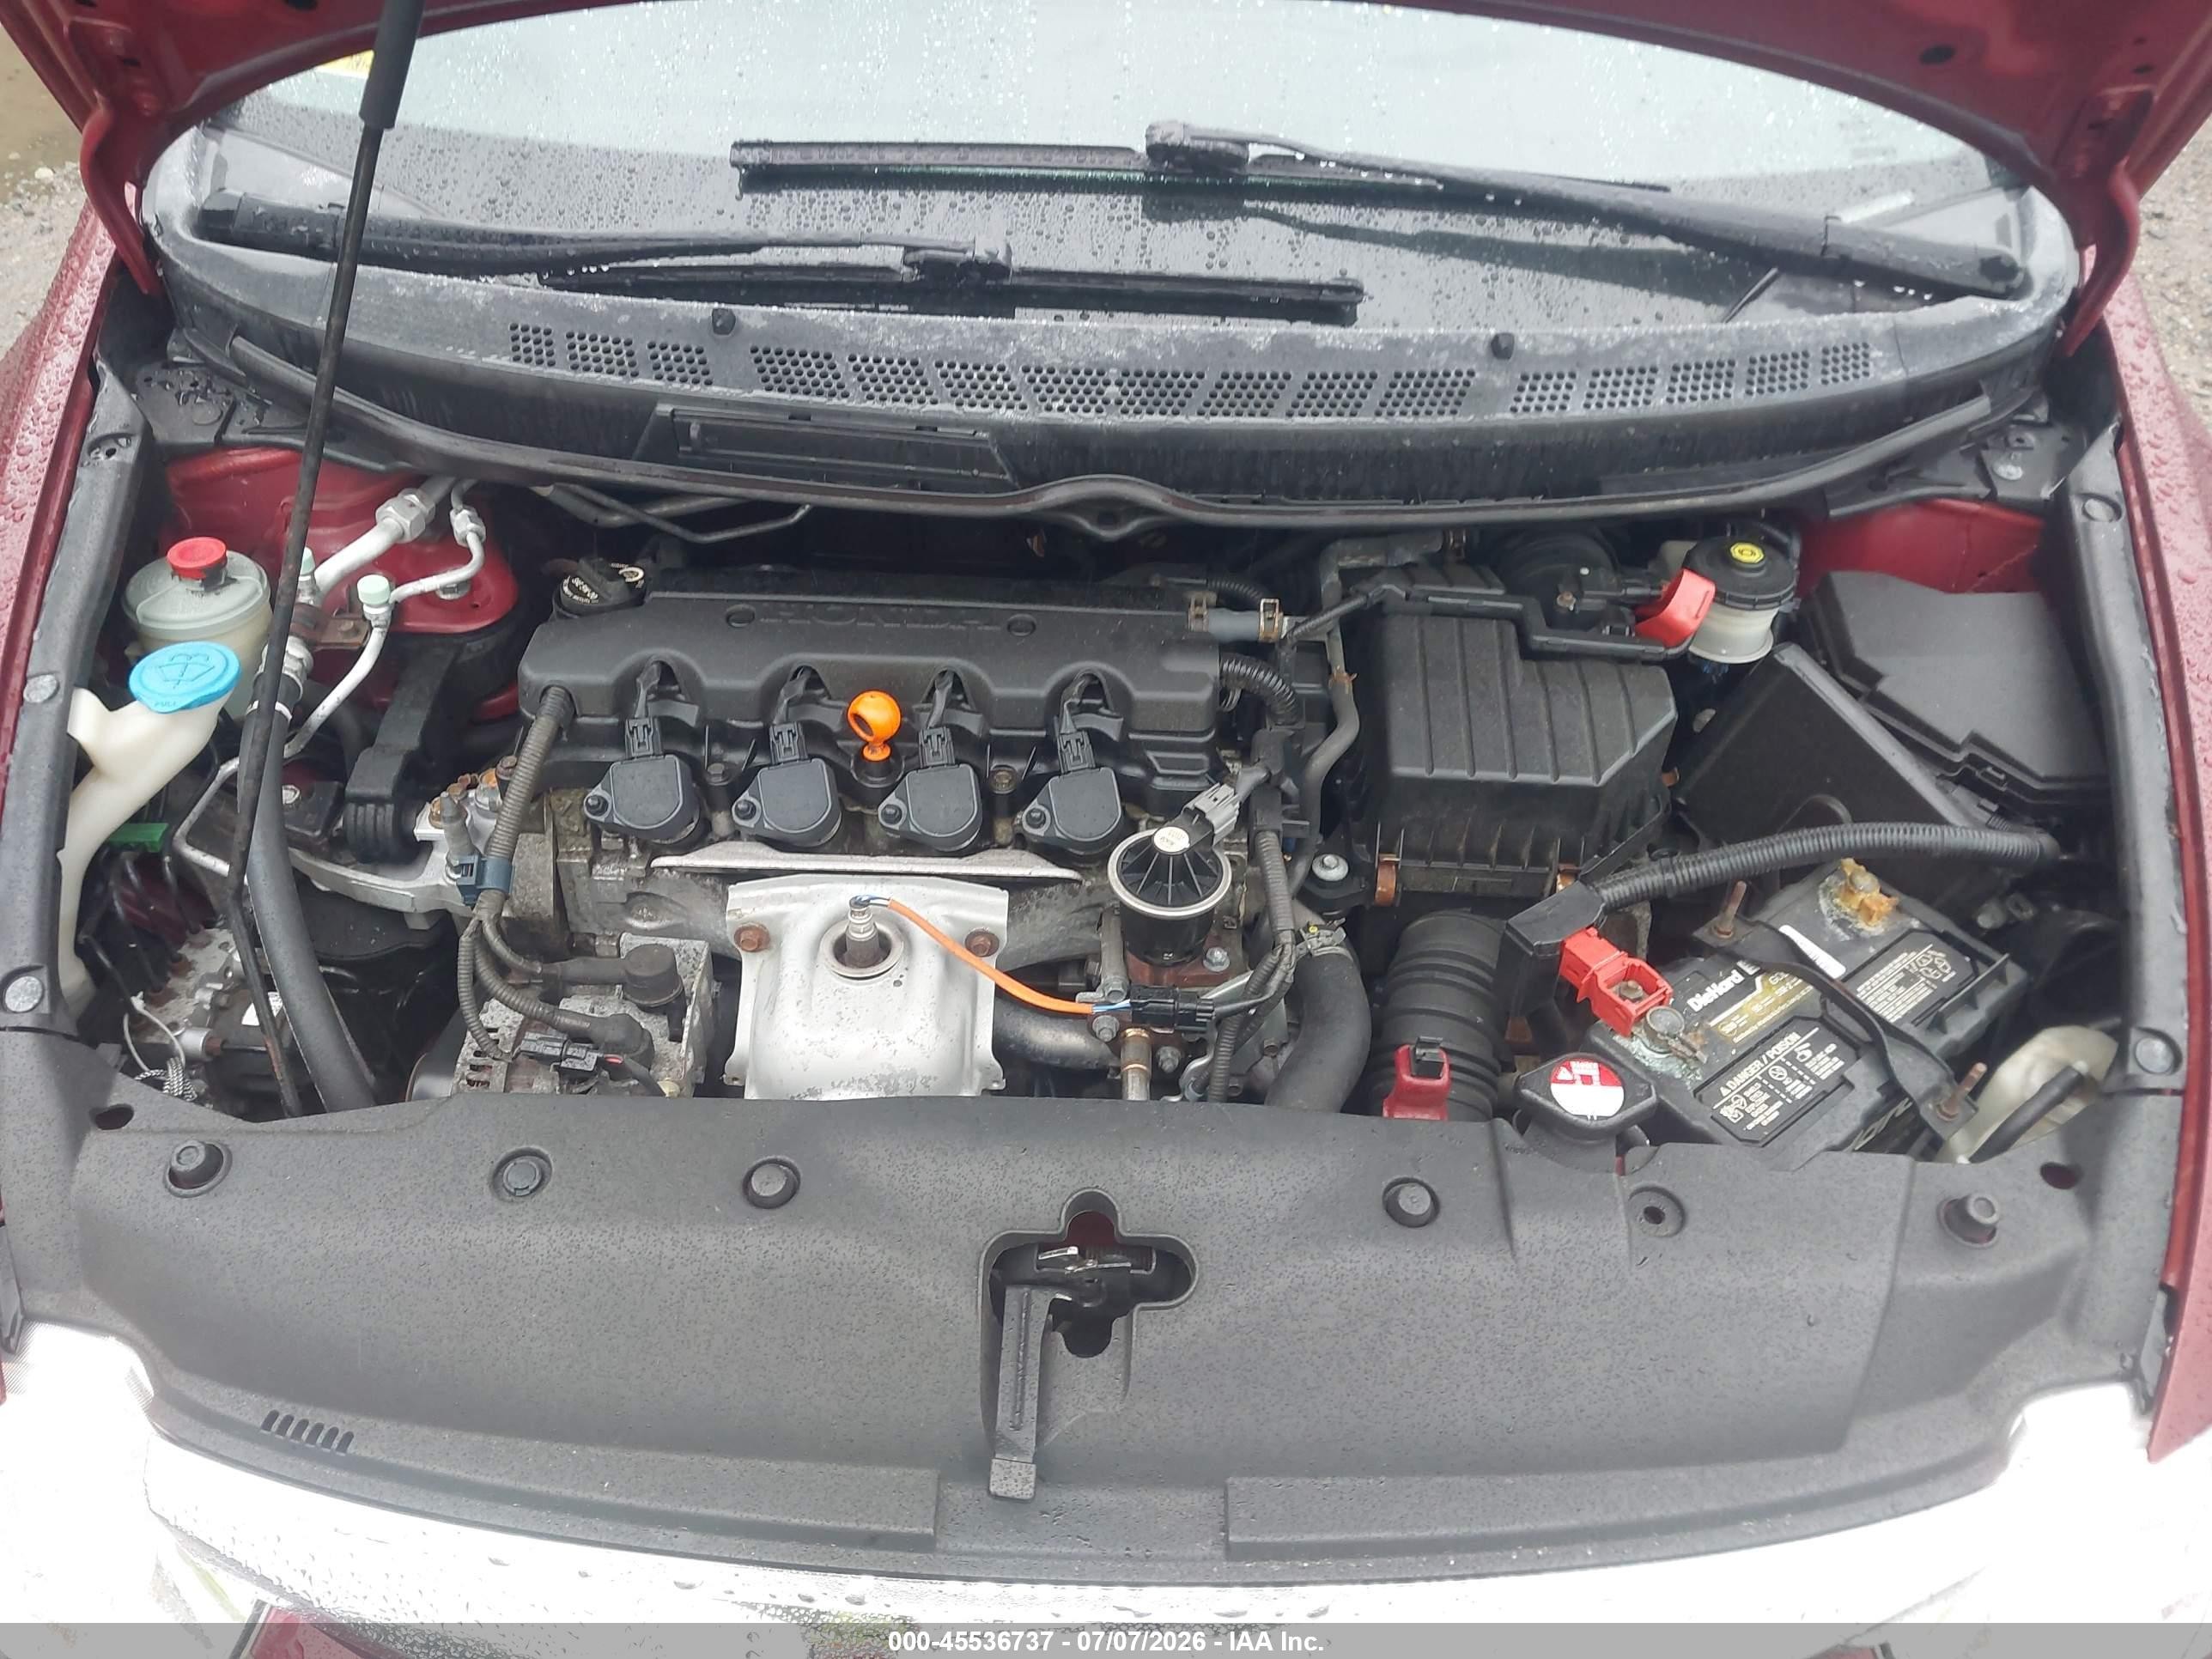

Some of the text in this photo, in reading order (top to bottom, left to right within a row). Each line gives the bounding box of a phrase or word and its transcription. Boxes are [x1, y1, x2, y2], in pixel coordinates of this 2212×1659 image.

[1687, 969, 1745, 1012] DieHard
[1729, 1060, 1762, 1090] DANGER
[1767, 1032, 1802, 1060] POISON
